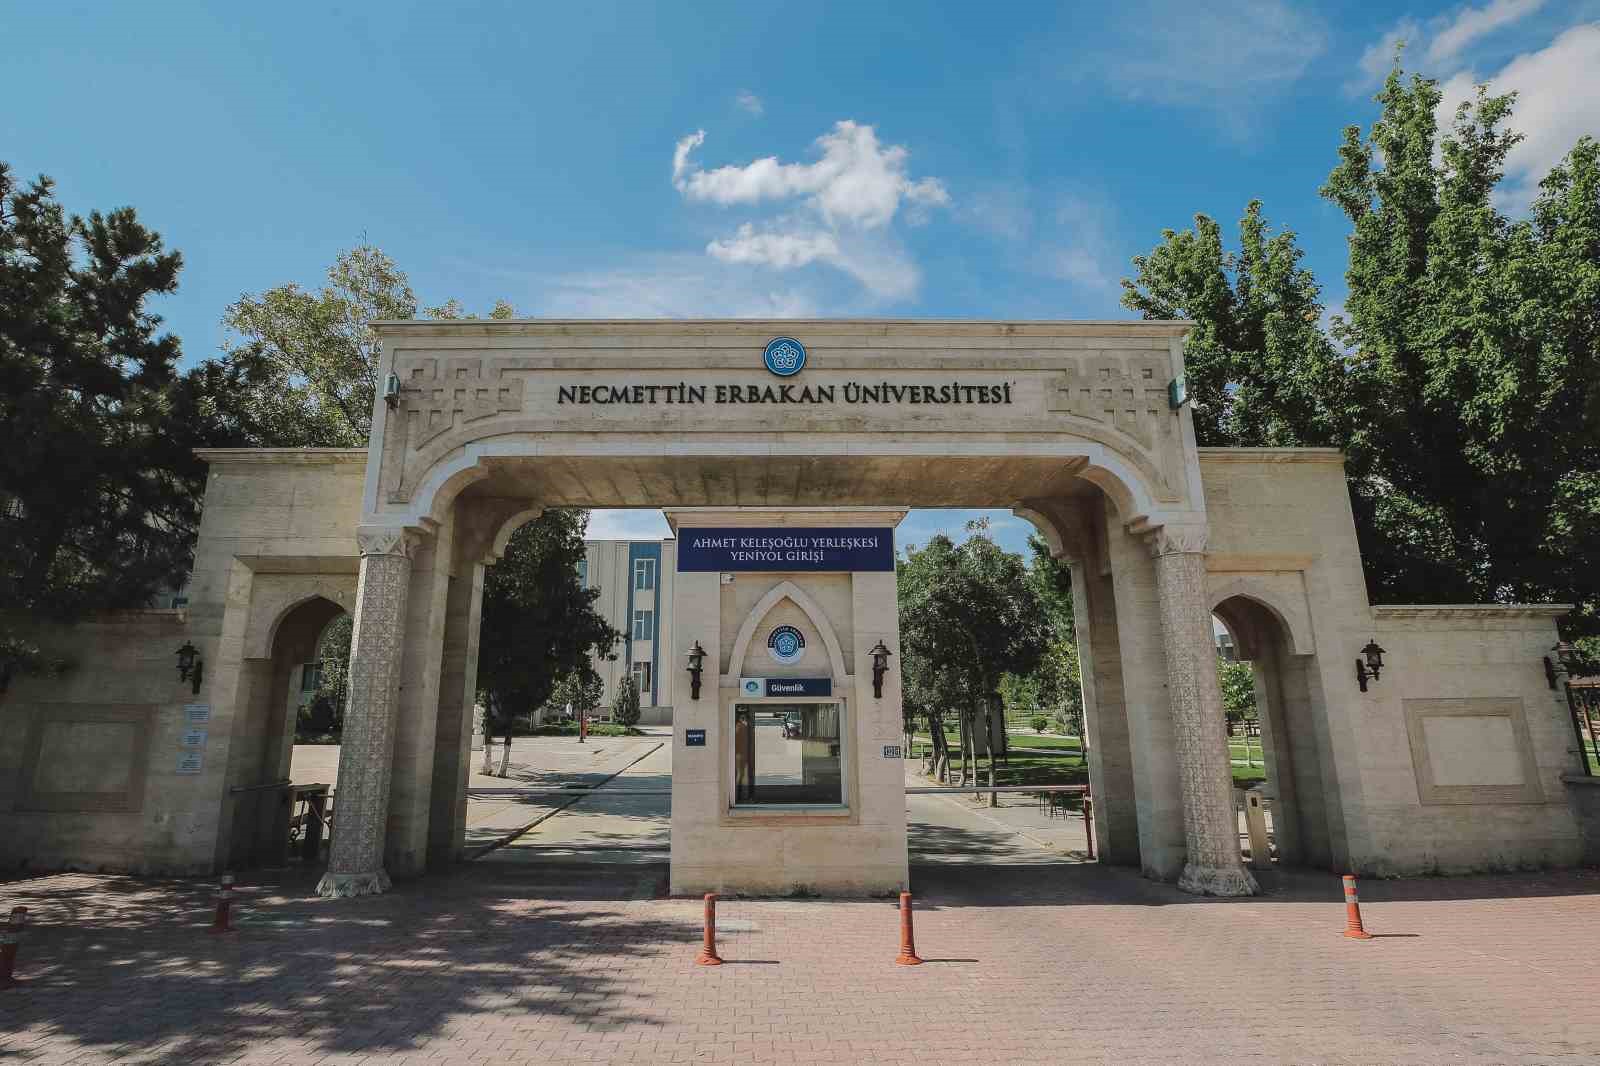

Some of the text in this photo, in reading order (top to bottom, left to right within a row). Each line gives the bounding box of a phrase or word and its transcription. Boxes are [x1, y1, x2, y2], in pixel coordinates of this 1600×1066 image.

[557, 381, 1013, 405] NECMETTİN ERBAKAN ÜNİVERSİTESİ
[692, 536, 879, 551] AHMET KELEŞOĞLU YERLEŞKESİ
[730, 549, 825, 564] YENİYOL GİRİŞİ
[771, 682, 805, 693] Güvenlik
